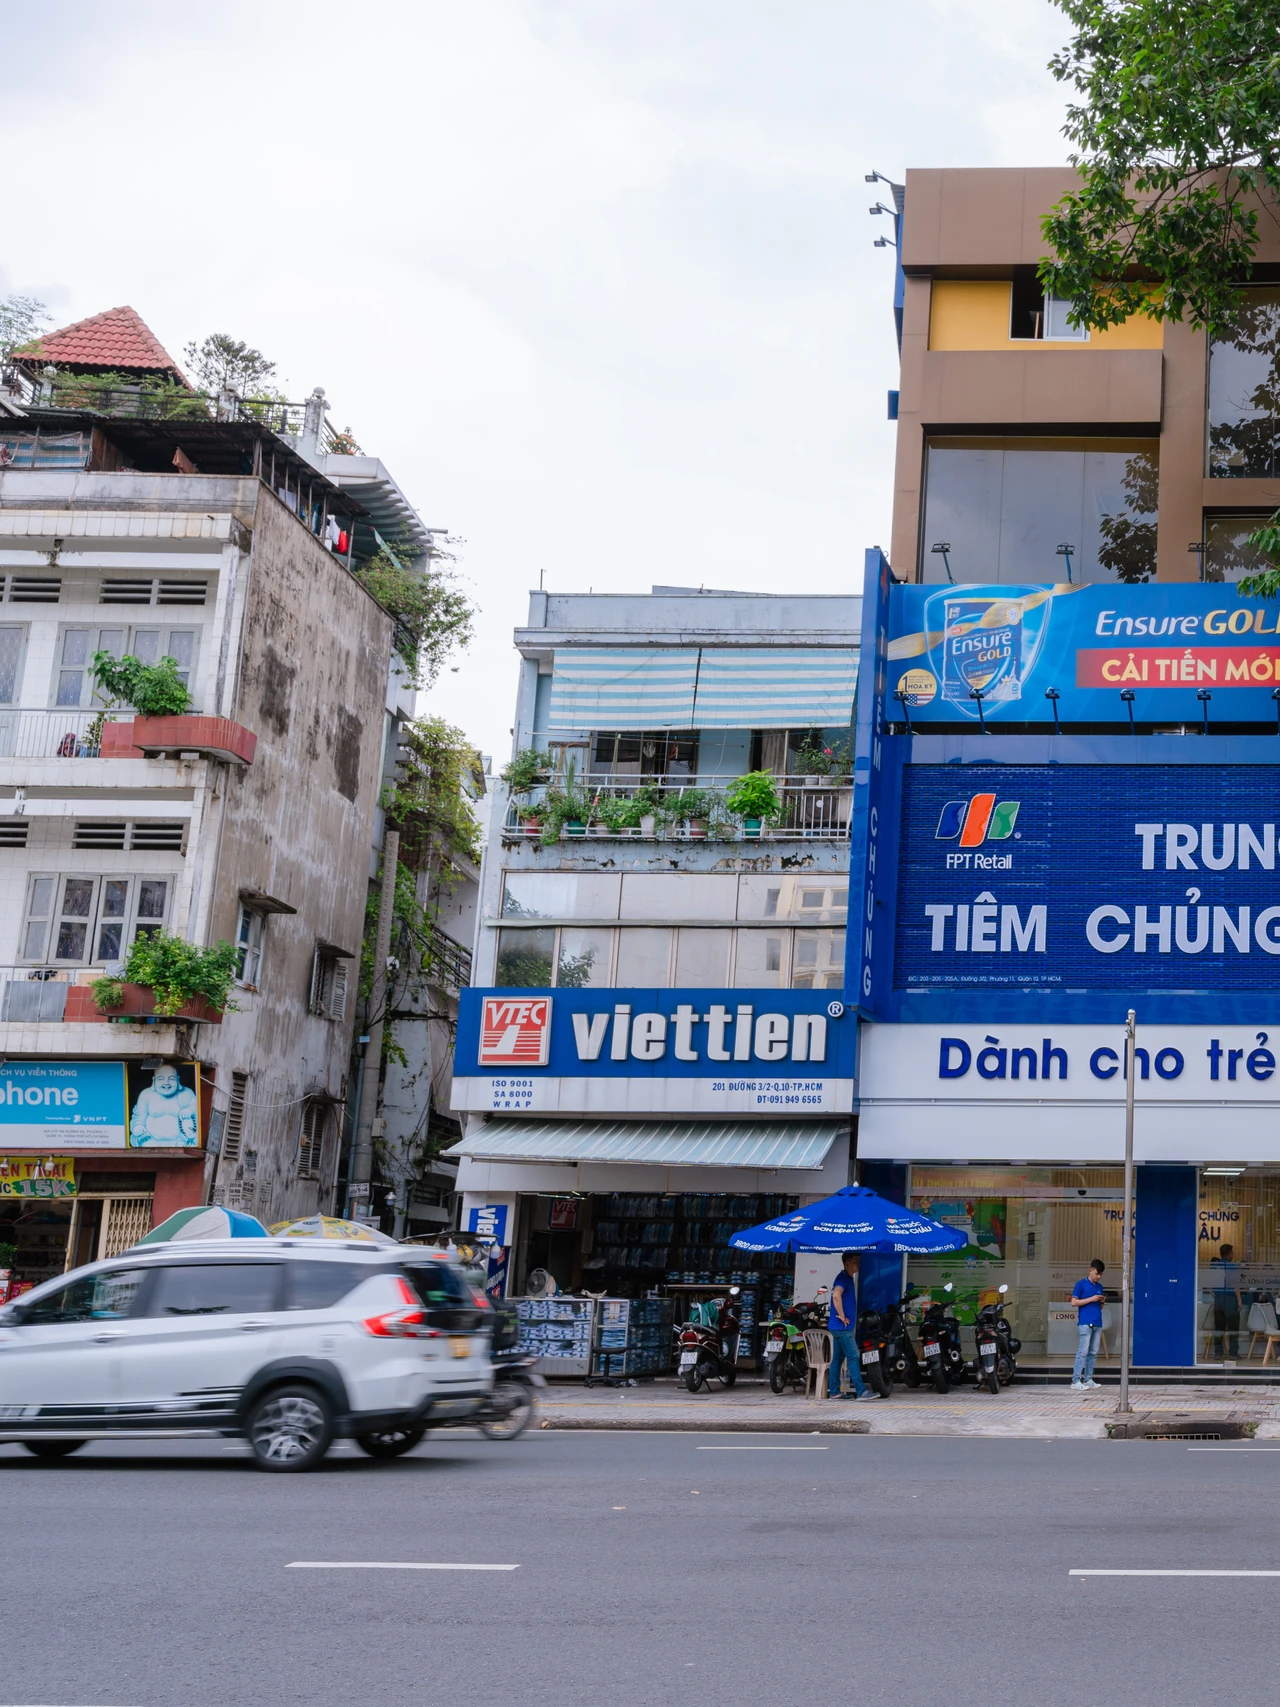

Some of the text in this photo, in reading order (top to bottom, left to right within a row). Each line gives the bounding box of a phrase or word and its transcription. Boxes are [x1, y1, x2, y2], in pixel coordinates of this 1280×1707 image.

[1095, 609, 1199, 636] Ensure
[952, 630, 1012, 656] Ensure
[978, 646, 1012, 662] GOLD
[1102, 653, 1149, 681] CẢI
[1156, 648, 1218, 681] TIẾN
[946, 853, 1013, 870] FPT Retail
[924, 891, 1048, 952] TIÊM
[487, 1002, 546, 1029] VTEC
[571, 1004, 828, 1062] viettien
[938, 1034, 1068, 1080] Dành
[1089, 1038, 1185, 1080] cho
[1207, 1031, 1276, 1081] trẻ
[14, 1069, 26, 1077] VỤ
[27, 1067, 47, 1076] VIỄN
[48, 1068, 78, 1077] THÔNG
[492, 1080, 533, 1088] ISO 9001
[712, 1082, 726, 1091] 201
[728, 1080, 757, 1091] ĐƯỜNG
[494, 1090, 533, 1098] SA 8000
[785, 1095, 800, 1104] 949
[801, 1095, 822, 1104] 6565
[20, 1180, 72, 1197] 15K
[555, 1201, 577, 1212] VTEC
[1104, 1209, 1136, 1220] TRU
[909, 1225, 933, 1234] CHÂU
